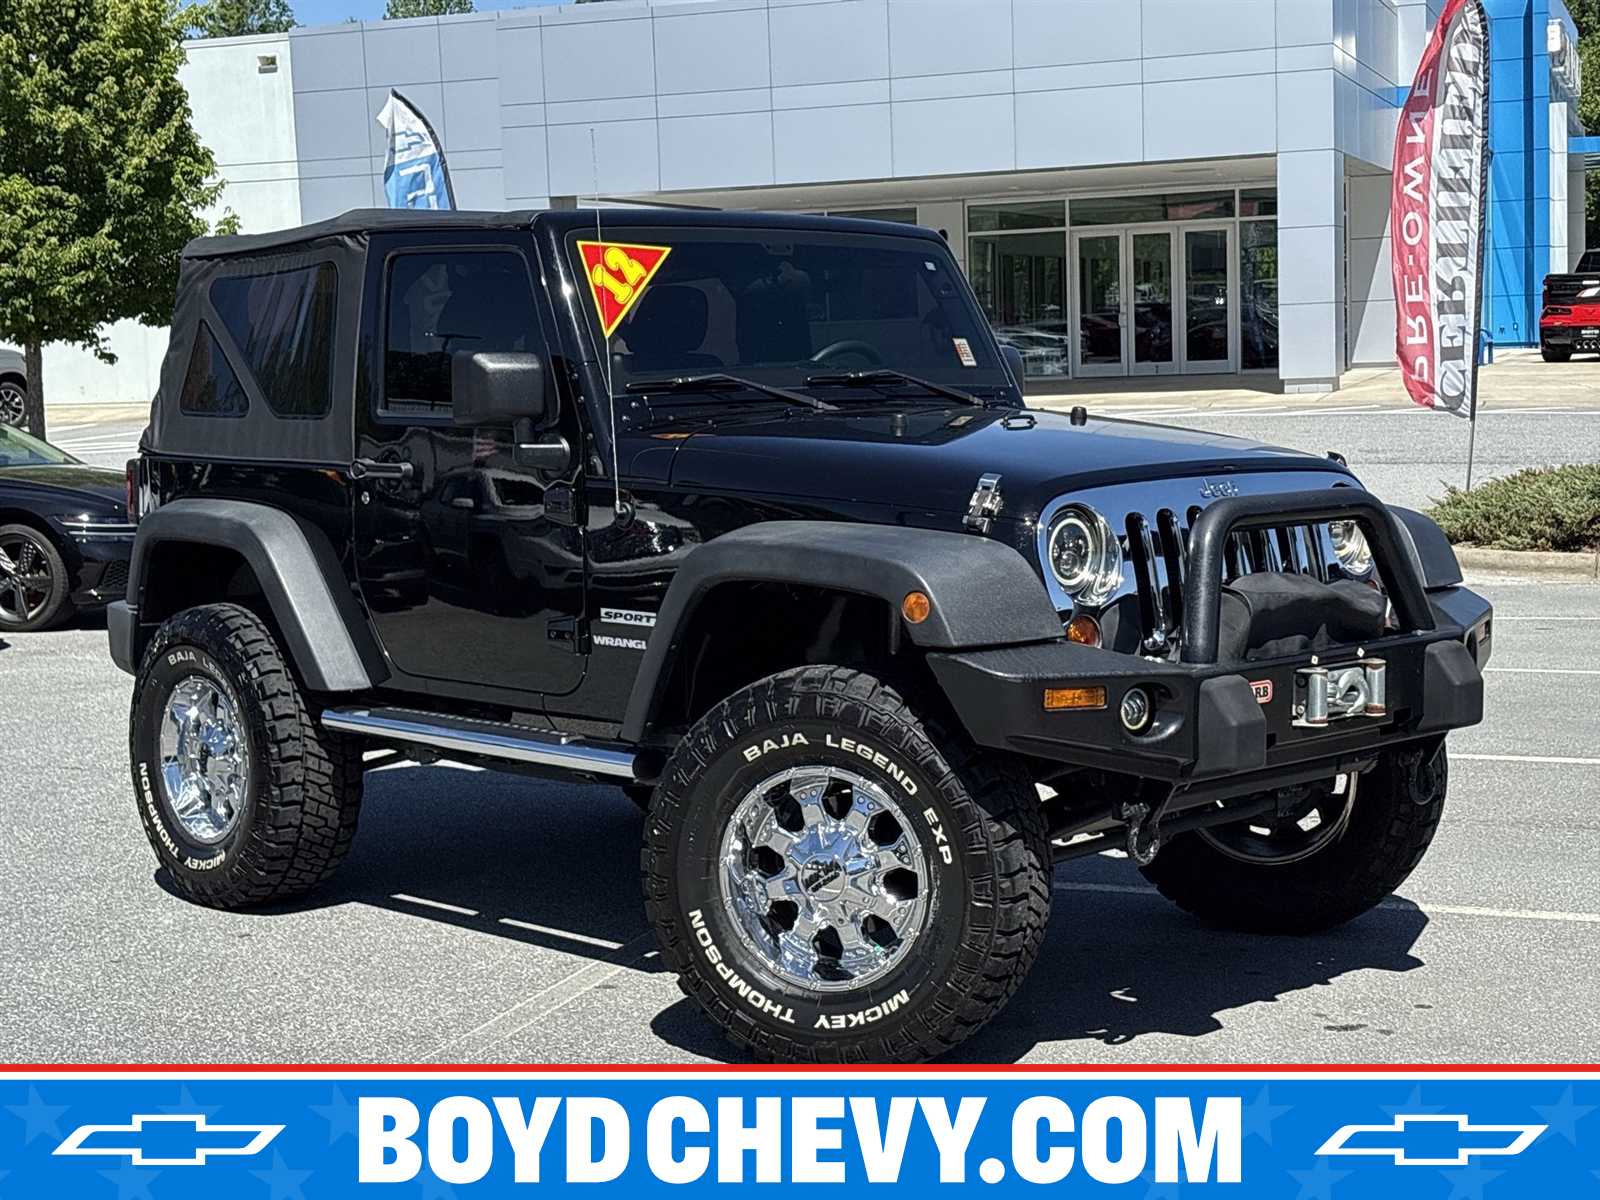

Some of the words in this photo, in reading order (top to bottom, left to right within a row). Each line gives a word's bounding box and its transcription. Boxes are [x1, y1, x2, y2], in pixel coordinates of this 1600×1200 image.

[593, 246, 647, 304] 12
[1200, 478, 1239, 498] Jeep
[603, 611, 652, 624] SPORT
[167, 650, 197, 666] BAJA
[139, 762, 180, 859] THOMPSON
[742, 732, 810, 762] BAJA
[826, 733, 918, 796] LEGEND
[923, 807, 952, 865] EXP
[183, 848, 227, 871] MICKEY
[687, 908, 796, 1025] THOMPSON
[814, 988, 911, 1030] MICKEY
